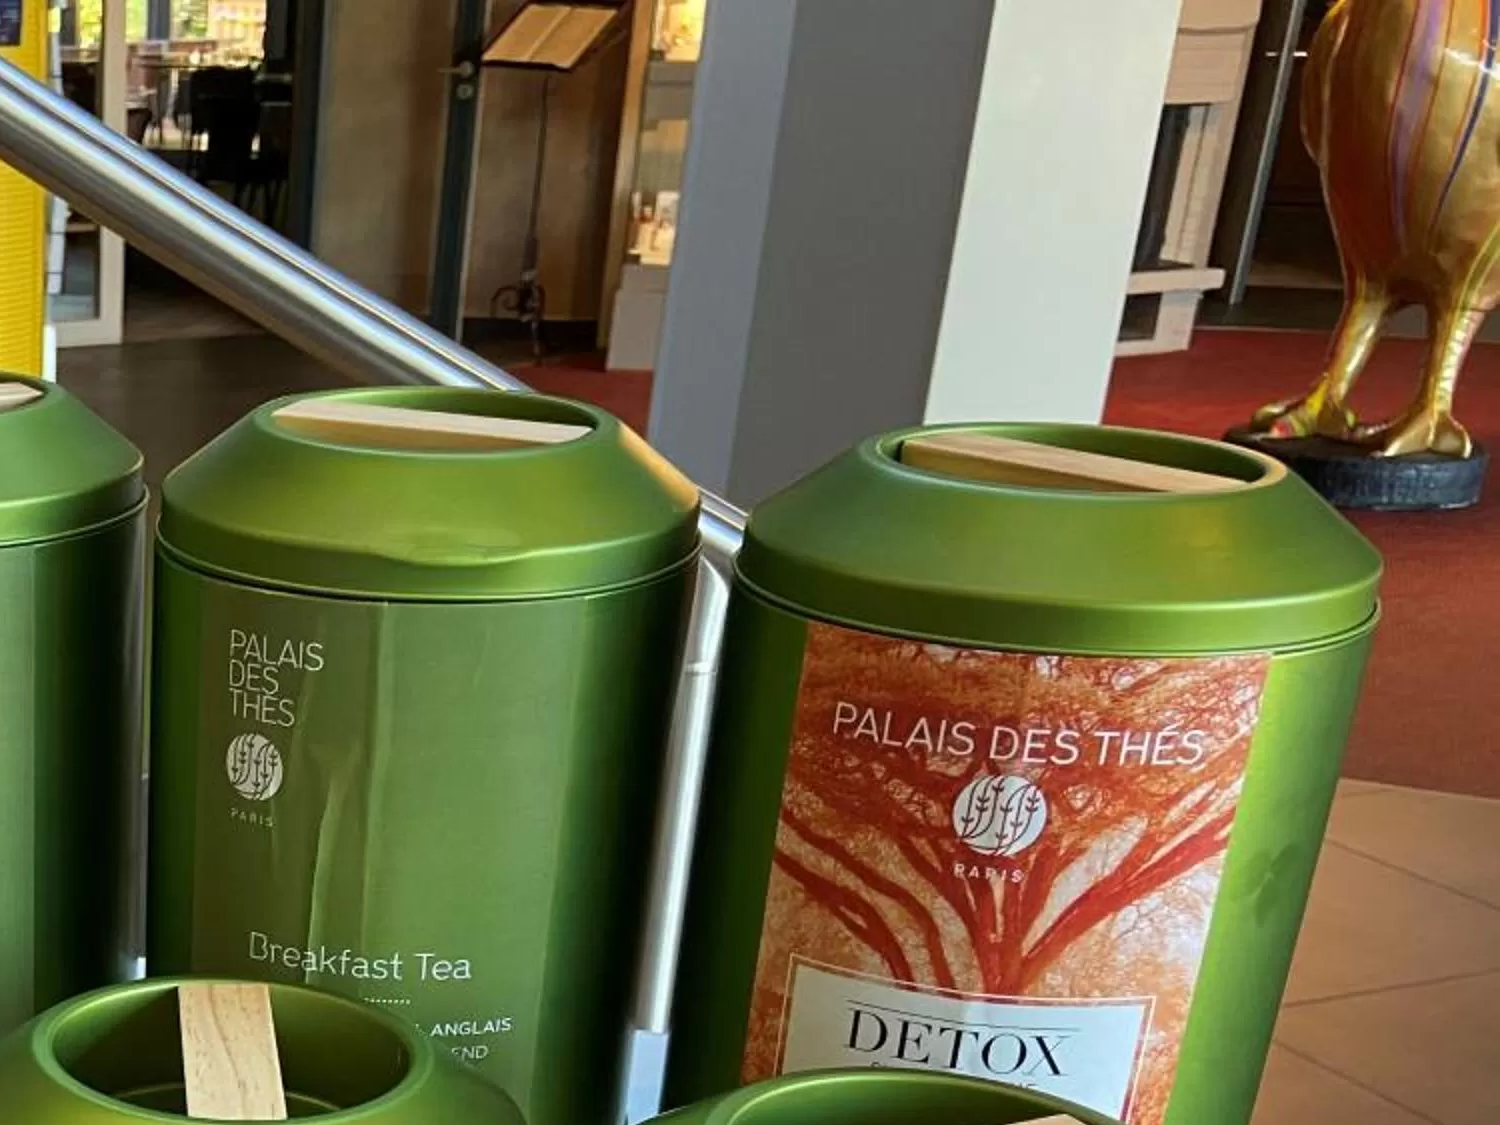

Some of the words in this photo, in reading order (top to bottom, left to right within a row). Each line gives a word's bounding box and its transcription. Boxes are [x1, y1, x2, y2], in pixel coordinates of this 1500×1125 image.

[229, 629, 324, 671] PALAIS
[228, 659, 279, 694] DES
[832, 700, 977, 757] PALAIS
[989, 726, 1080, 766] DES
[1093, 724, 1207, 766] THÉS
[231, 807, 274, 828] PARIS
[954, 862, 1025, 884] PARIS
[249, 931, 403, 980] Breakfast
[414, 952, 472, 981] Tea
[430, 1018, 512, 1037] ANGLAIS
[843, 1007, 1073, 1077] DETOX
